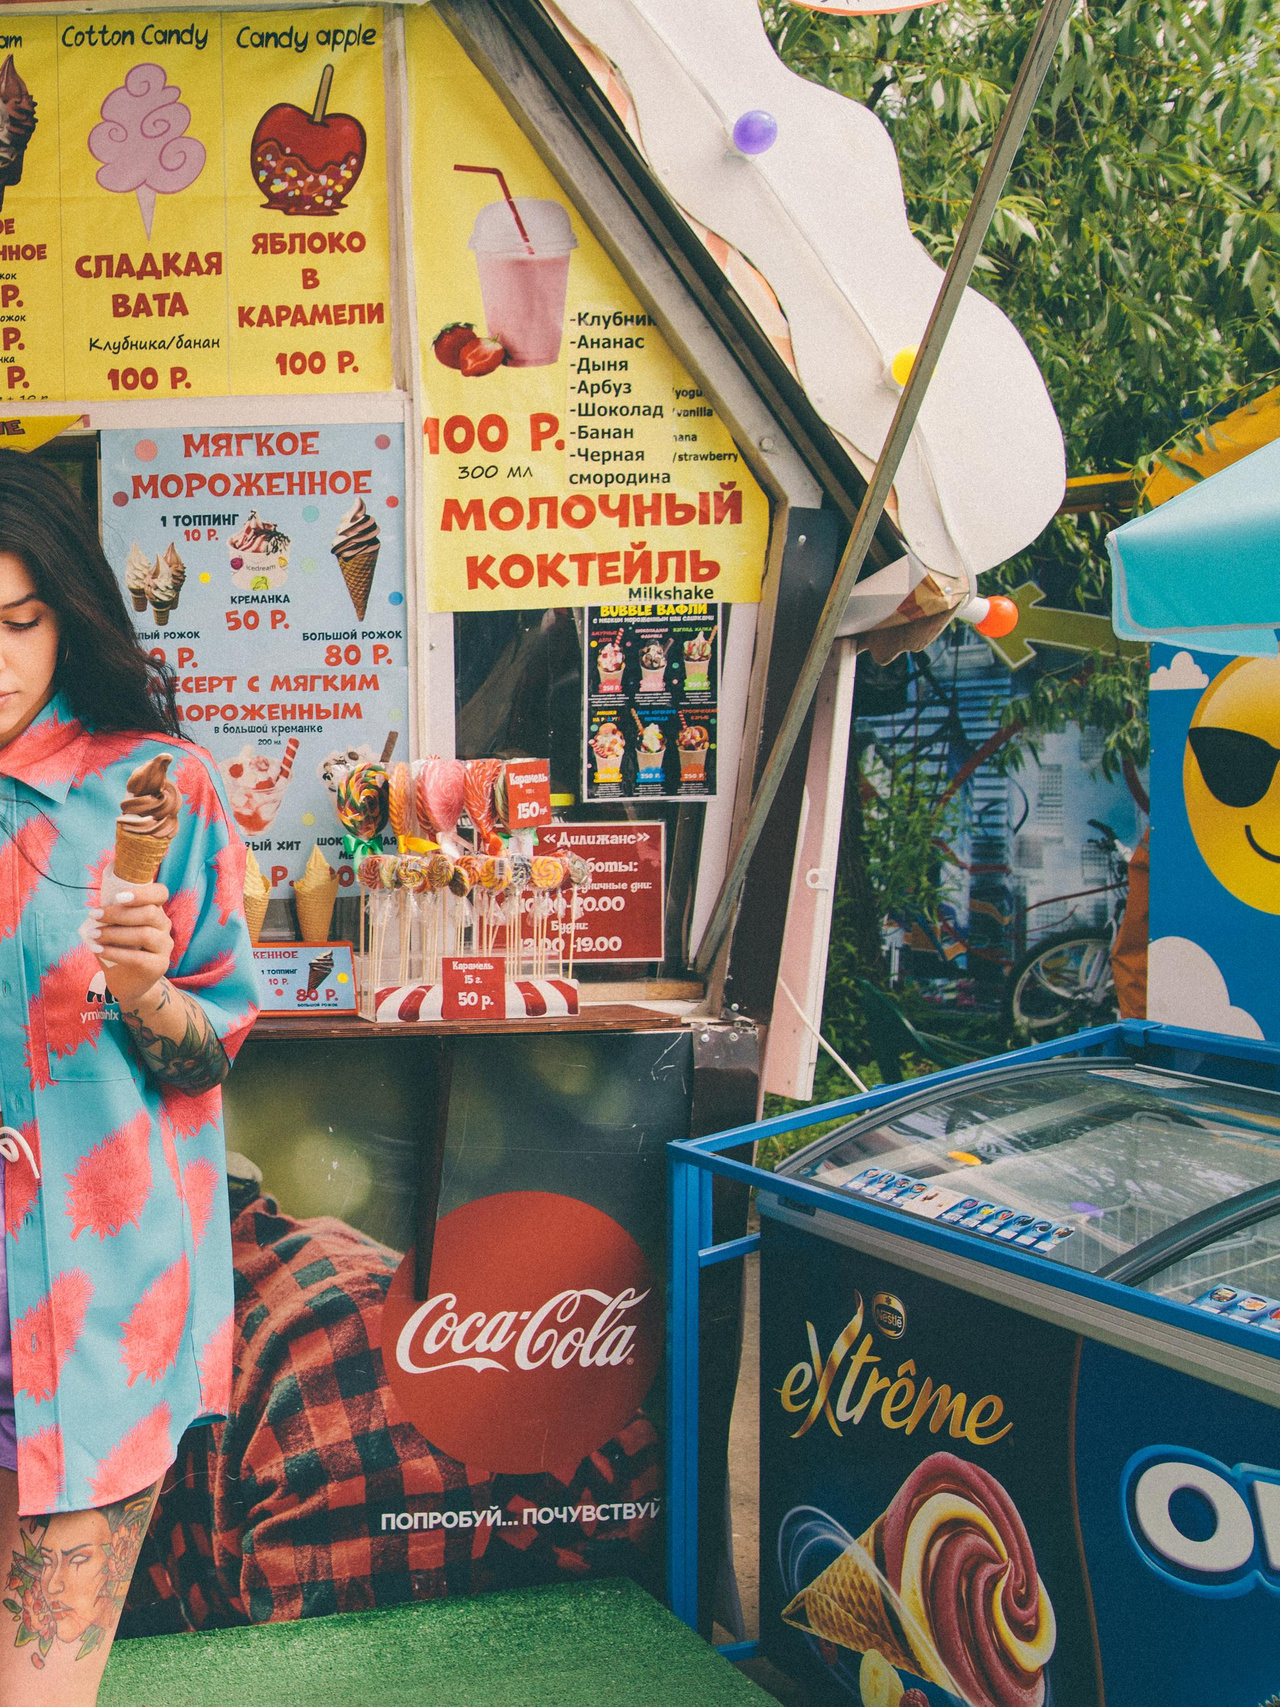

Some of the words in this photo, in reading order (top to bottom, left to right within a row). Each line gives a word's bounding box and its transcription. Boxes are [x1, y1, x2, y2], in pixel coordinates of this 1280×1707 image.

[62, 25, 135, 48] Cotton
[141, 24, 208, 49] Candy
[236, 26, 308, 52] Candy
[316, 24, 376, 53] apple
[251, 231, 366, 255] ЯБЛОКО
[75, 252, 222, 280] СЛАДКАЯ
[302, 268, 320, 289] В
[1, 284, 24, 308] Р.
[112, 291, 189, 318] ВАТА
[238, 302, 384, 328] КАРАМЕЛИ
[2, 327, 25, 350] Р.
[89, 335, 220, 354] Клубника/банан
[569, 334, 645, 350] -Ананас
[276, 352, 329, 376] 100
[338, 351, 359, 374] Р.
[7, 366, 29, 389] Р.
[108, 368, 158, 390] 100
[170, 367, 191, 390] Р.
[183, 431, 320, 458] МЯГКОЕ
[422, 413, 508, 456] 100
[530, 413, 566, 452] Р.
[673, 451, 738, 462] /strawberry
[458, 465, 498, 479] 300
[569, 470, 670, 486] смородина
[131, 470, 372, 499] МОРОЖЕННОЕ
[440, 481, 743, 532] МОЛОЧНЫЙ
[173, 513, 239, 527] ТОППИНГ
[184, 530, 202, 542] 10
[466, 542, 720, 591] КОКТЕЙЛЬ
[230, 594, 290, 605] КРЕМАНКА
[628, 585, 714, 600] Milkshake
[226, 610, 259, 631] 50
[270, 610, 290, 630] Р.
[164, 631, 200, 639] РОЖОК
[302, 629, 358, 641] БОЛЬШОЙ
[362, 629, 402, 640] РОЖОК
[324, 645, 361, 666] 80
[373, 644, 393, 665] Р.
[271, 674, 380, 692] МЯГКИМ
[223, 723, 268, 733] большой
[517, 802, 539, 819] 150
[277, 841, 301, 851] ХИТ
[464, 975, 473, 984] 15
[296, 989, 318, 1001] 80
[326, 989, 338, 1000] Р.
[458, 992, 478, 1006] 50
[482, 995, 494, 1010] р.
[396, 1288, 652, 1374] Coca-Cola
[381, 1506, 518, 1530] ПОПРОБУЙ...
